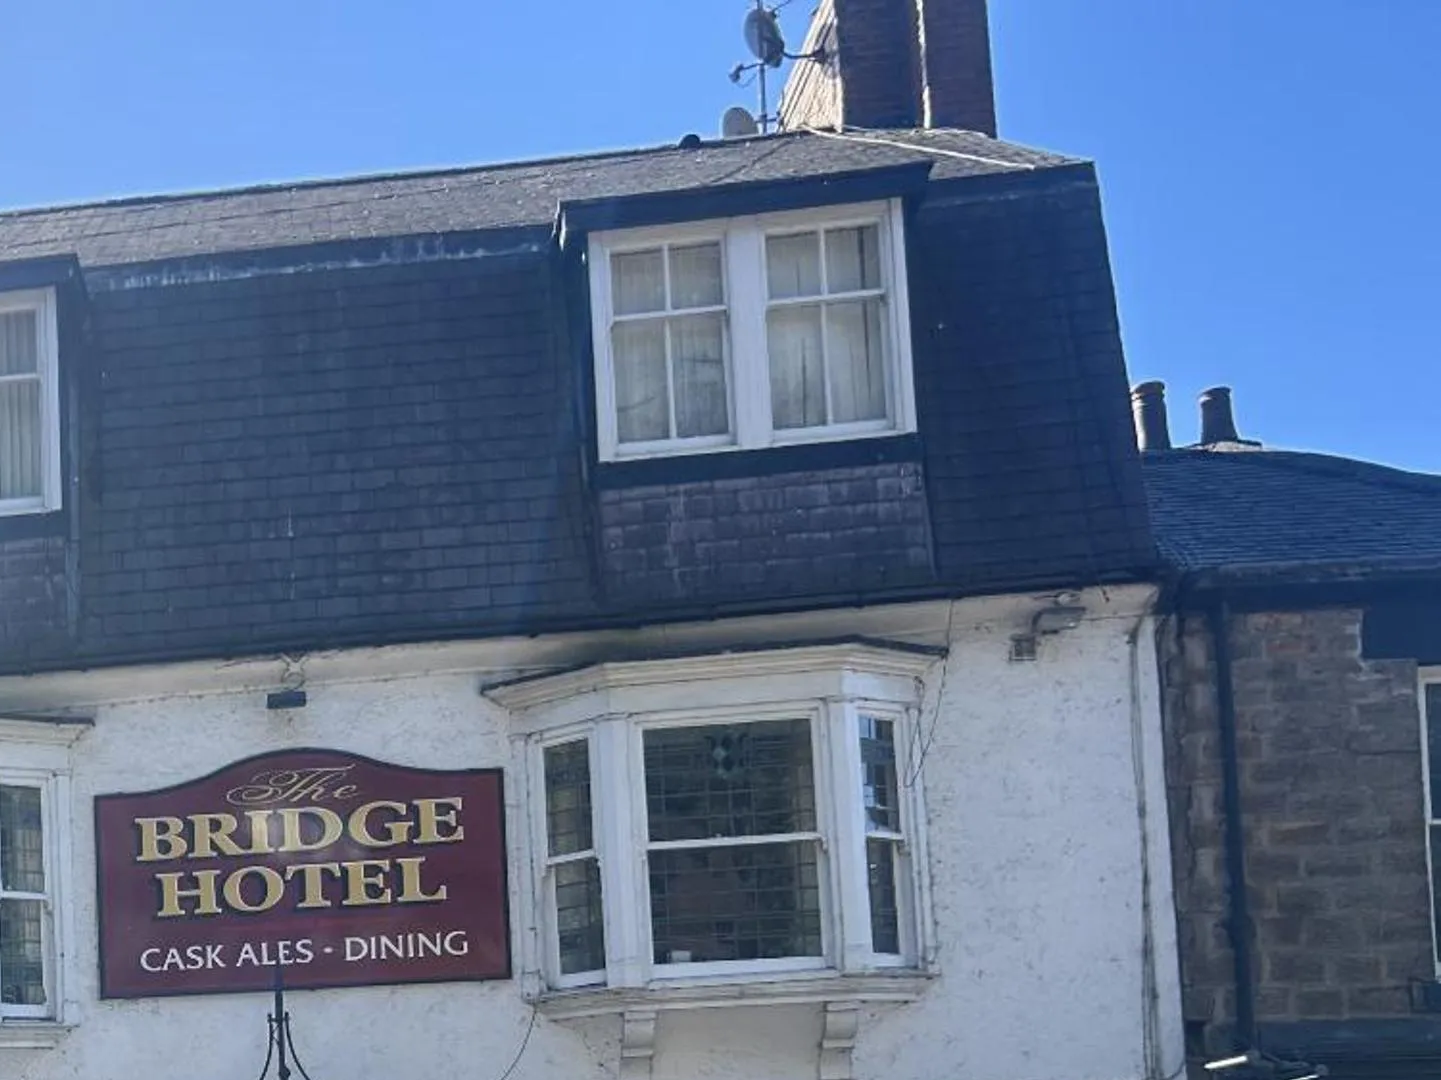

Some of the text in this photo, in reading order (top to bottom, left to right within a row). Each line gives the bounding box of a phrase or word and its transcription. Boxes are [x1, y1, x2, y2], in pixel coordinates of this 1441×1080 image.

[227, 763, 362, 805] The
[134, 797, 465, 862] BRIDGE
[155, 856, 448, 917] HOTEL
[140, 930, 469, 972] CASK ALES DINING
